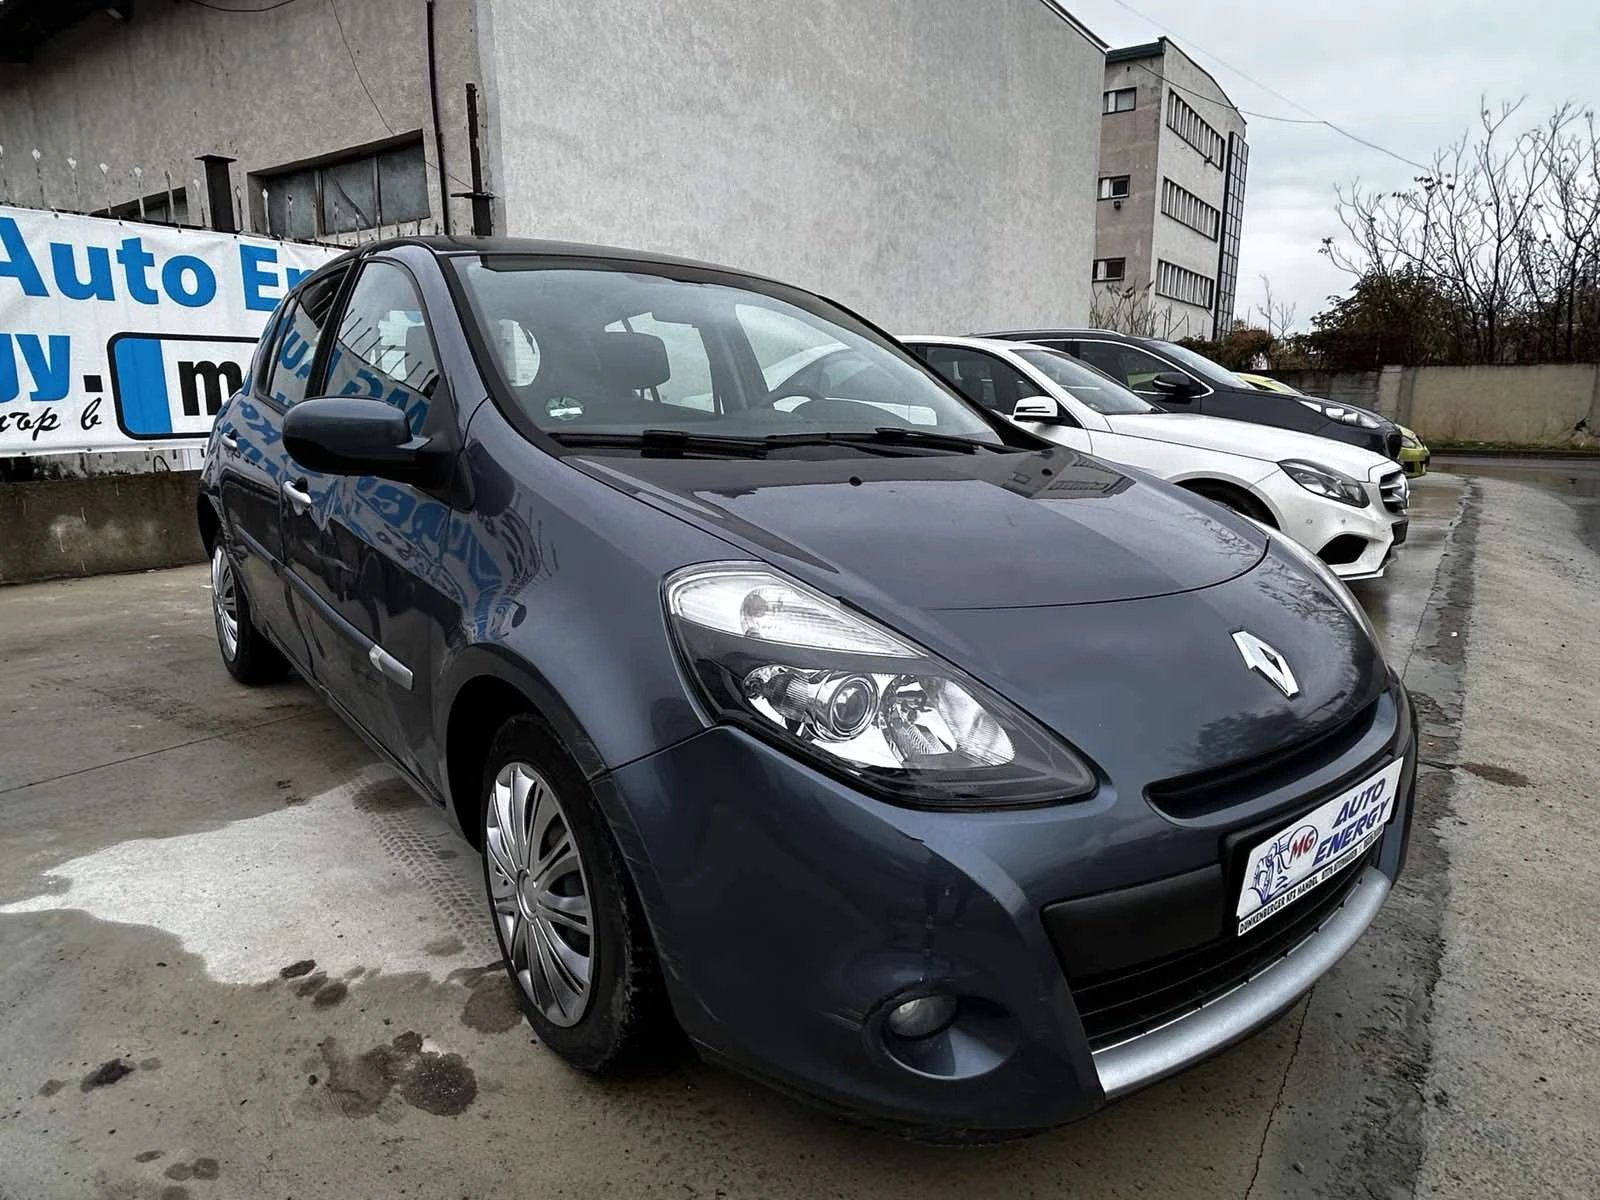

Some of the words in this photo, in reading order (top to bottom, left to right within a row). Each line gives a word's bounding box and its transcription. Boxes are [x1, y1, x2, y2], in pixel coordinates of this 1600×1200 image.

[1332, 778, 1386, 829] AUTO
[1288, 829, 1315, 865] MG
[1312, 797, 1391, 867] ENERGY
